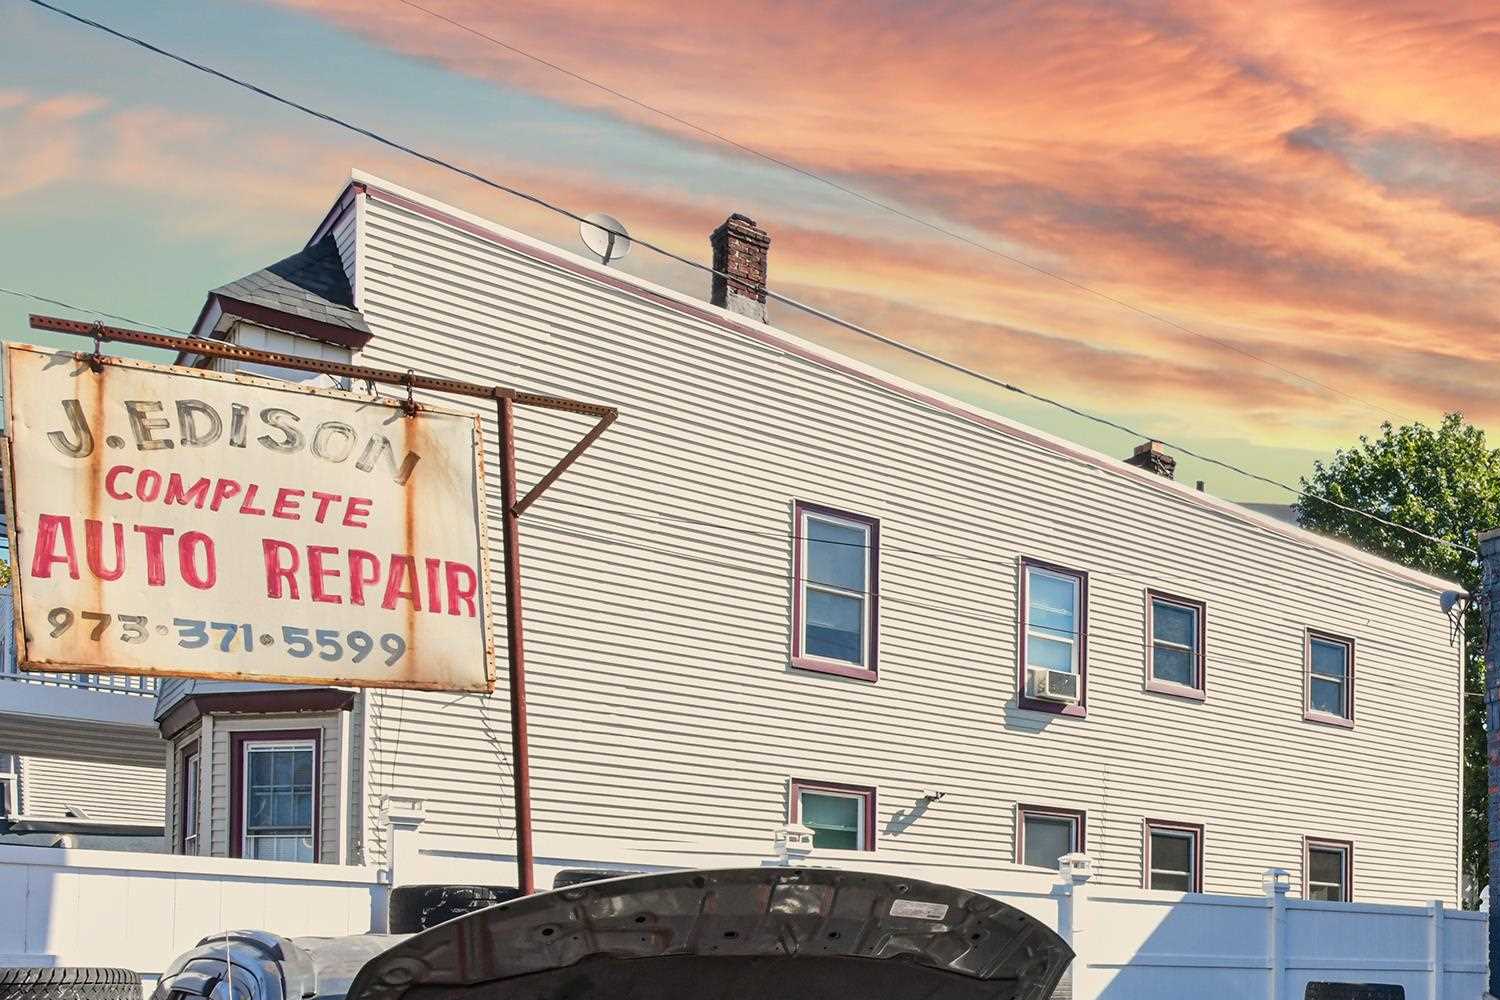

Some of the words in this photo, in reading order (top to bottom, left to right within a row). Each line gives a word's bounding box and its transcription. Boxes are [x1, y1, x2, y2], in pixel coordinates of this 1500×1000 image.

[105, 464, 374, 529] COMPLETE
[31, 513, 216, 591] AUTO
[262, 538, 477, 618] REPAIR
